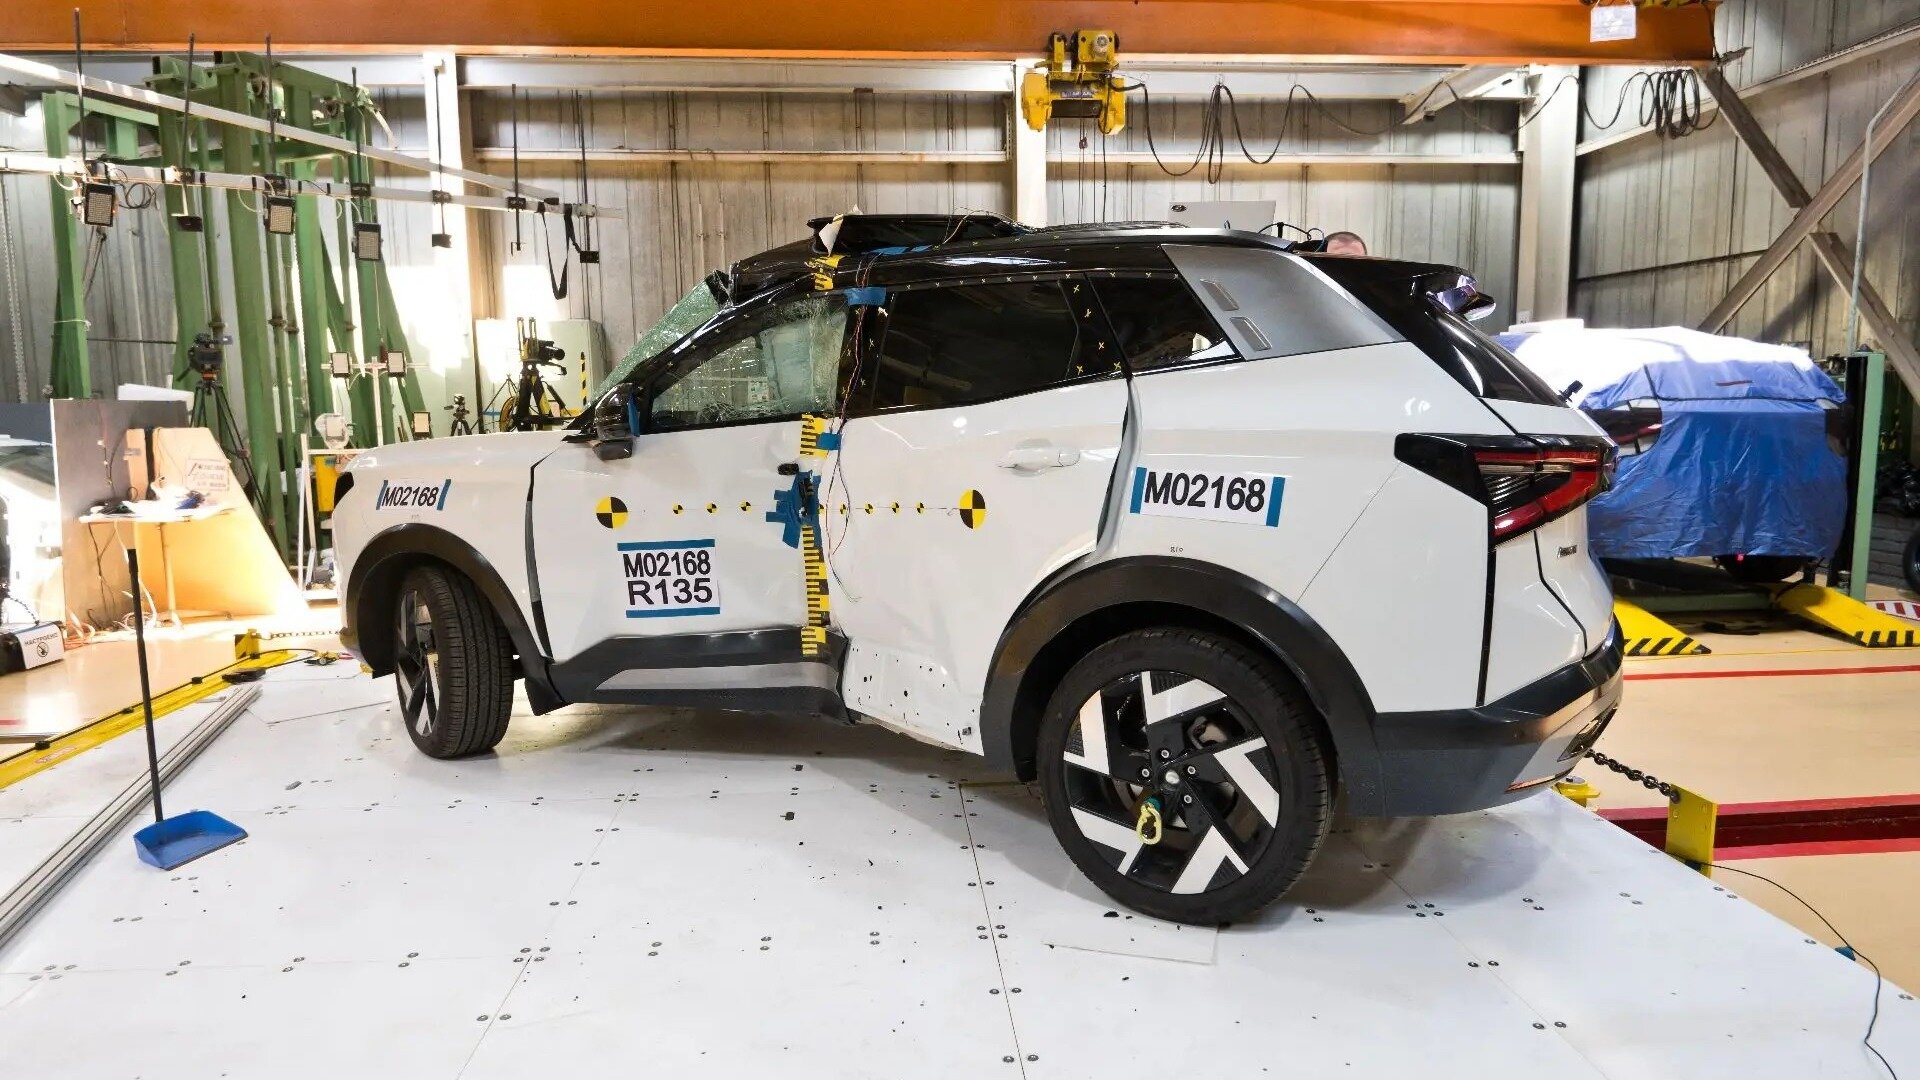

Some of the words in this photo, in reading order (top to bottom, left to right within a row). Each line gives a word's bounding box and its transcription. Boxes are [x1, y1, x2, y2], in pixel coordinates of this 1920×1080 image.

[381, 486, 440, 507] M02168
[1144, 471, 1266, 513] M02168
[622, 549, 711, 577] M02168
[627, 577, 713, 606] R135
